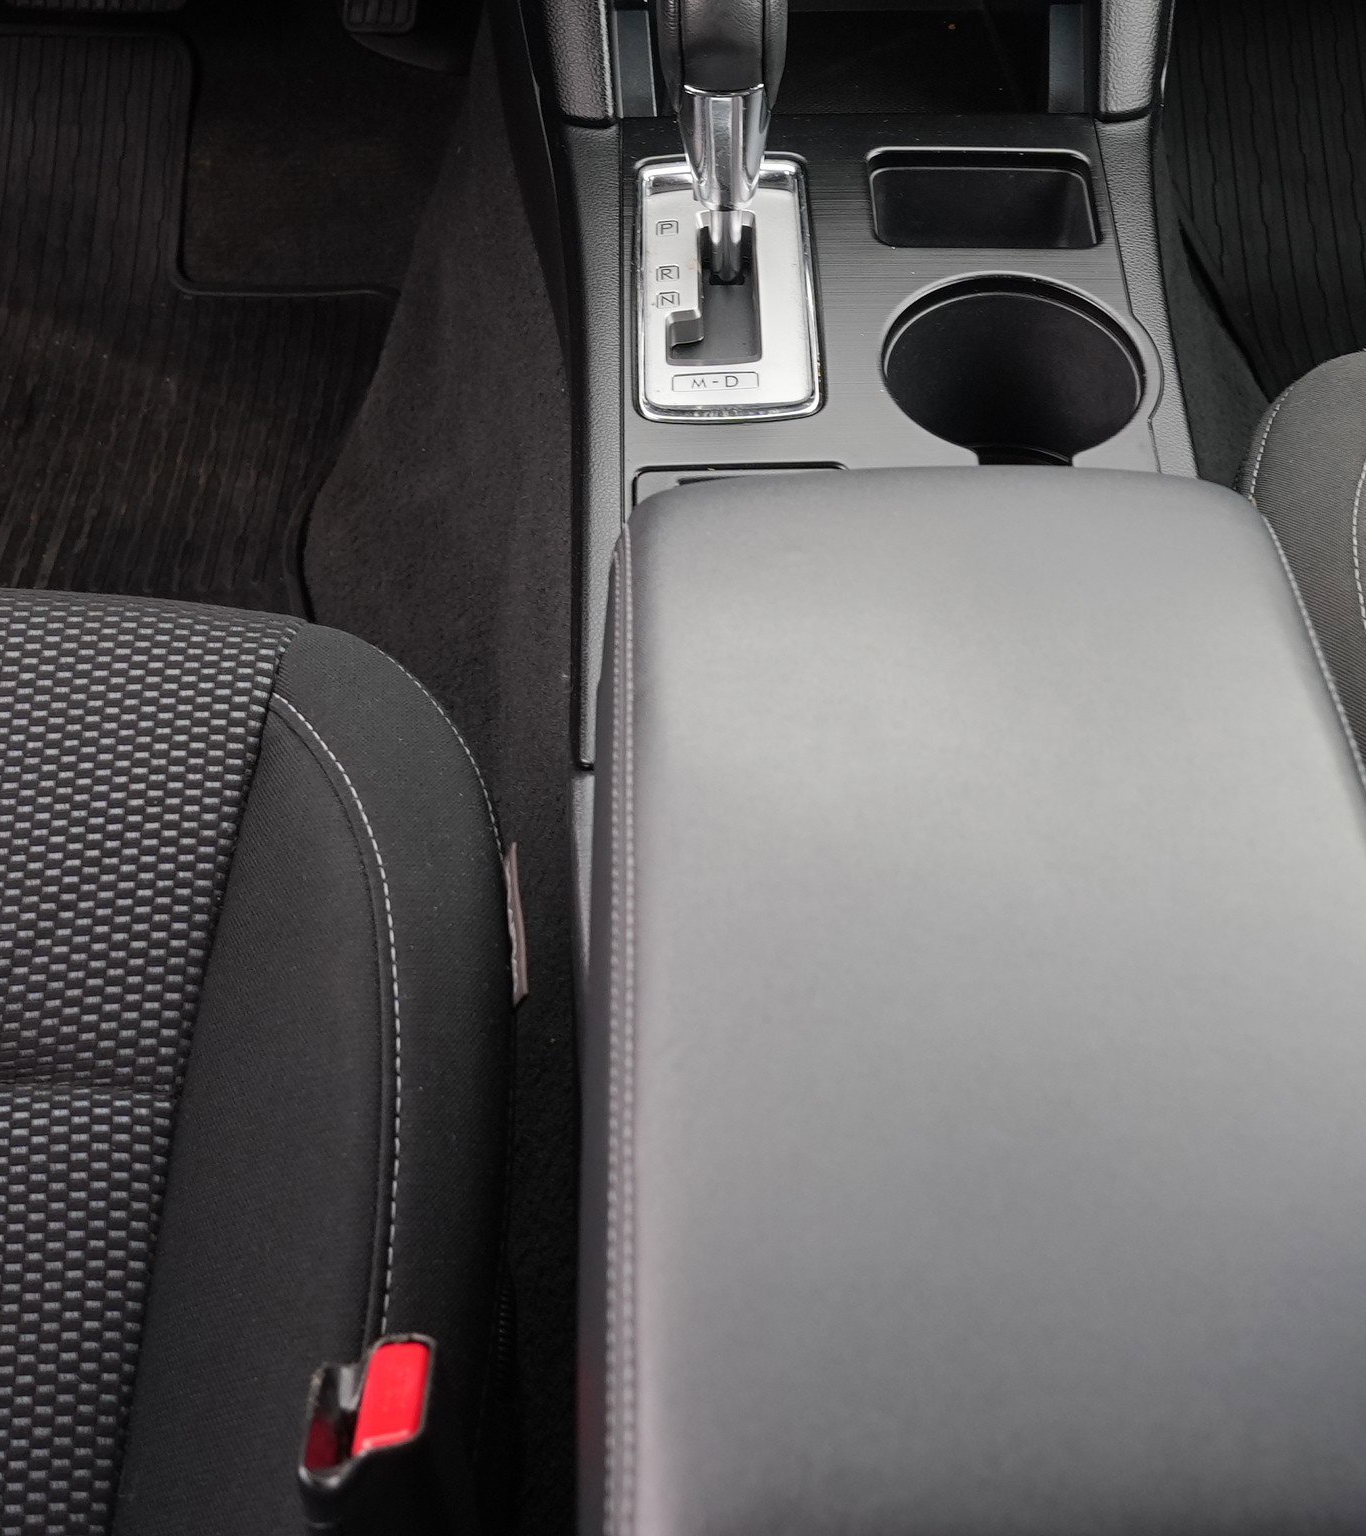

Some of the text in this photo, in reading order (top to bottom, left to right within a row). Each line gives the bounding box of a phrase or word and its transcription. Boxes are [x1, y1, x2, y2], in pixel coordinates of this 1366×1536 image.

[660, 224, 673, 235] P
[660, 268, 674, 280] R
[660, 295, 675, 306] N
